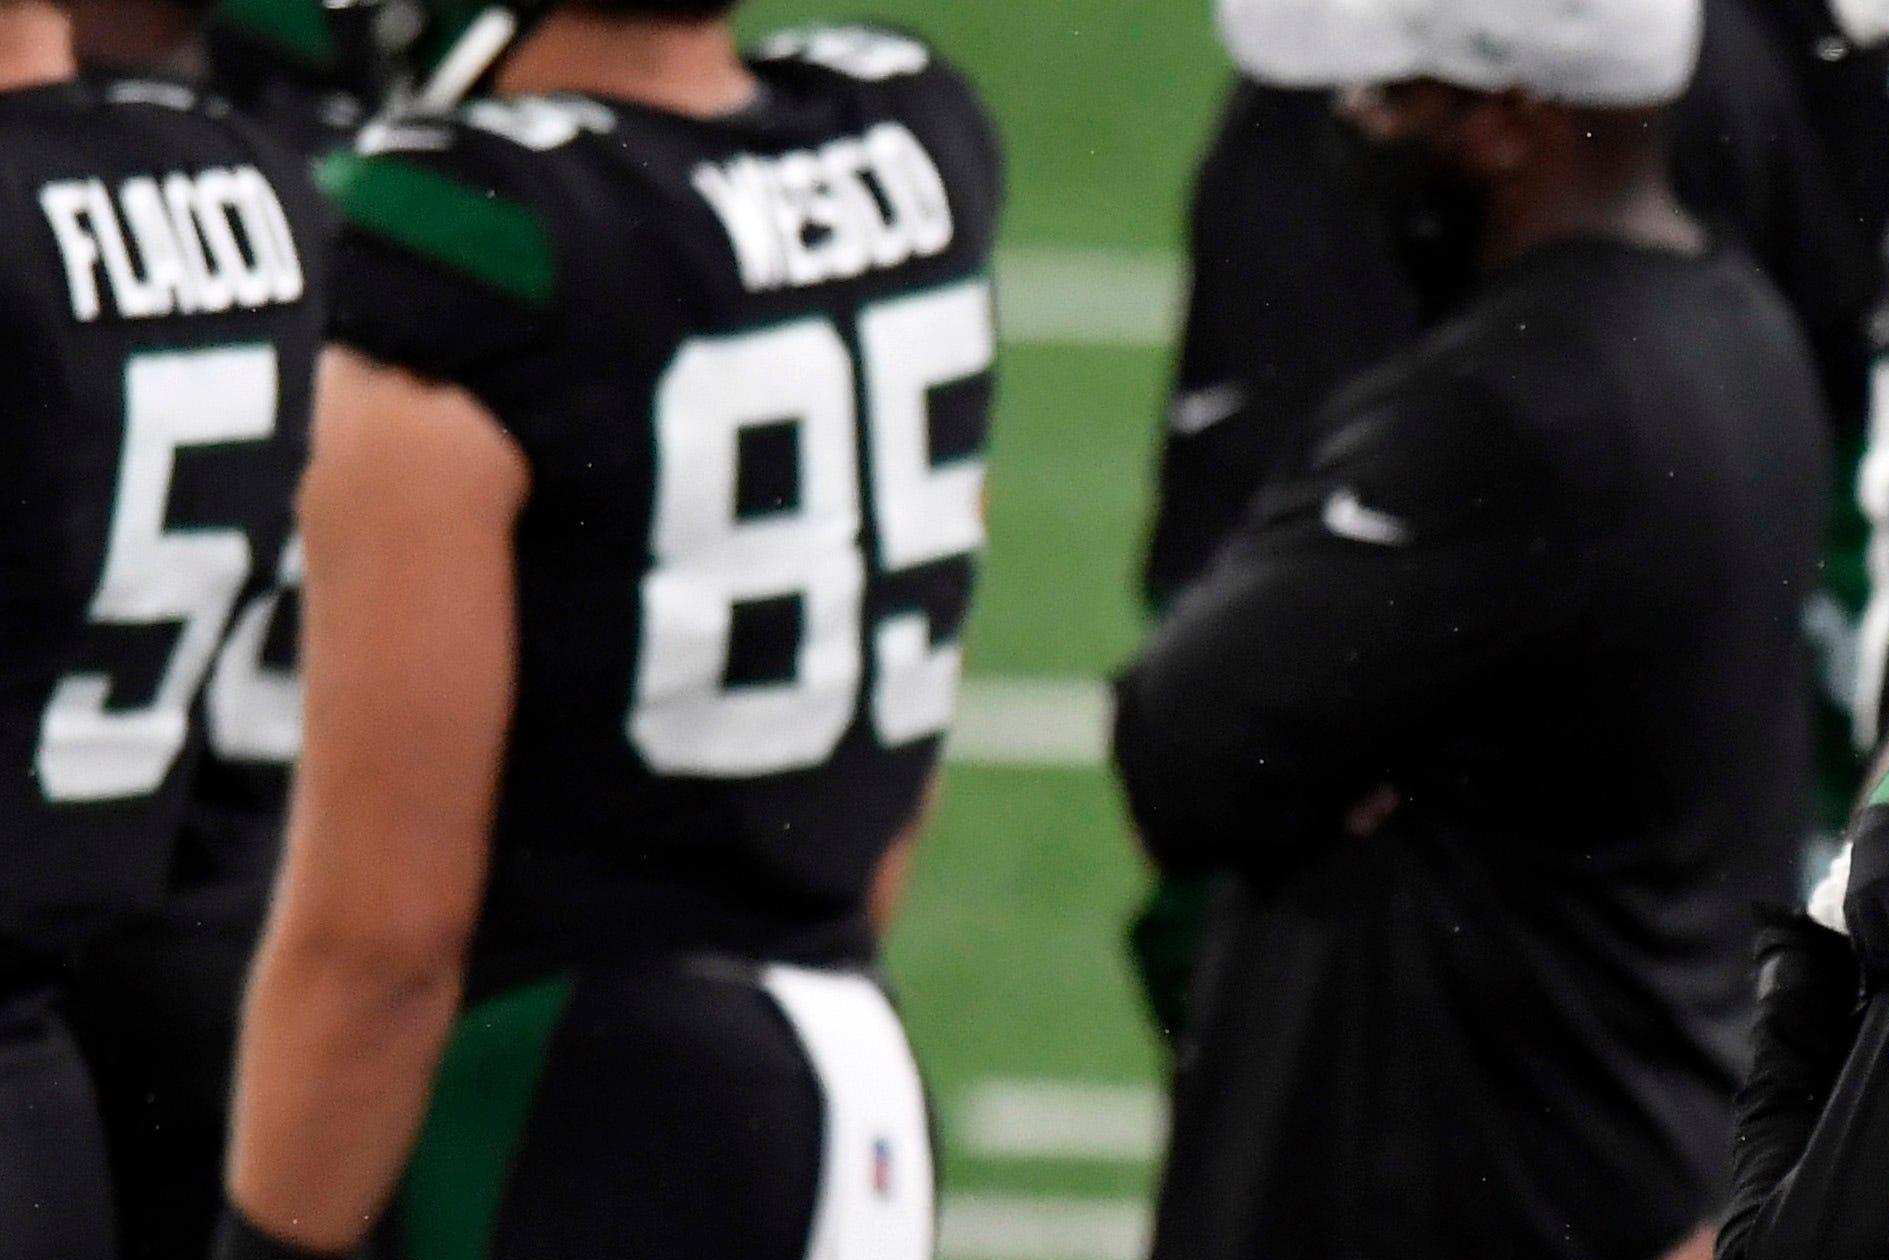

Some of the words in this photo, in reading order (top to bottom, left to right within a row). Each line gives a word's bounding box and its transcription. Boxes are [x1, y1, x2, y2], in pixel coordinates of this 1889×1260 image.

[36, 162, 305, 324] FLACCO
[689, 119, 955, 295] WESCO
[35, 344, 280, 803] 5
[624, 280, 996, 780] 85
